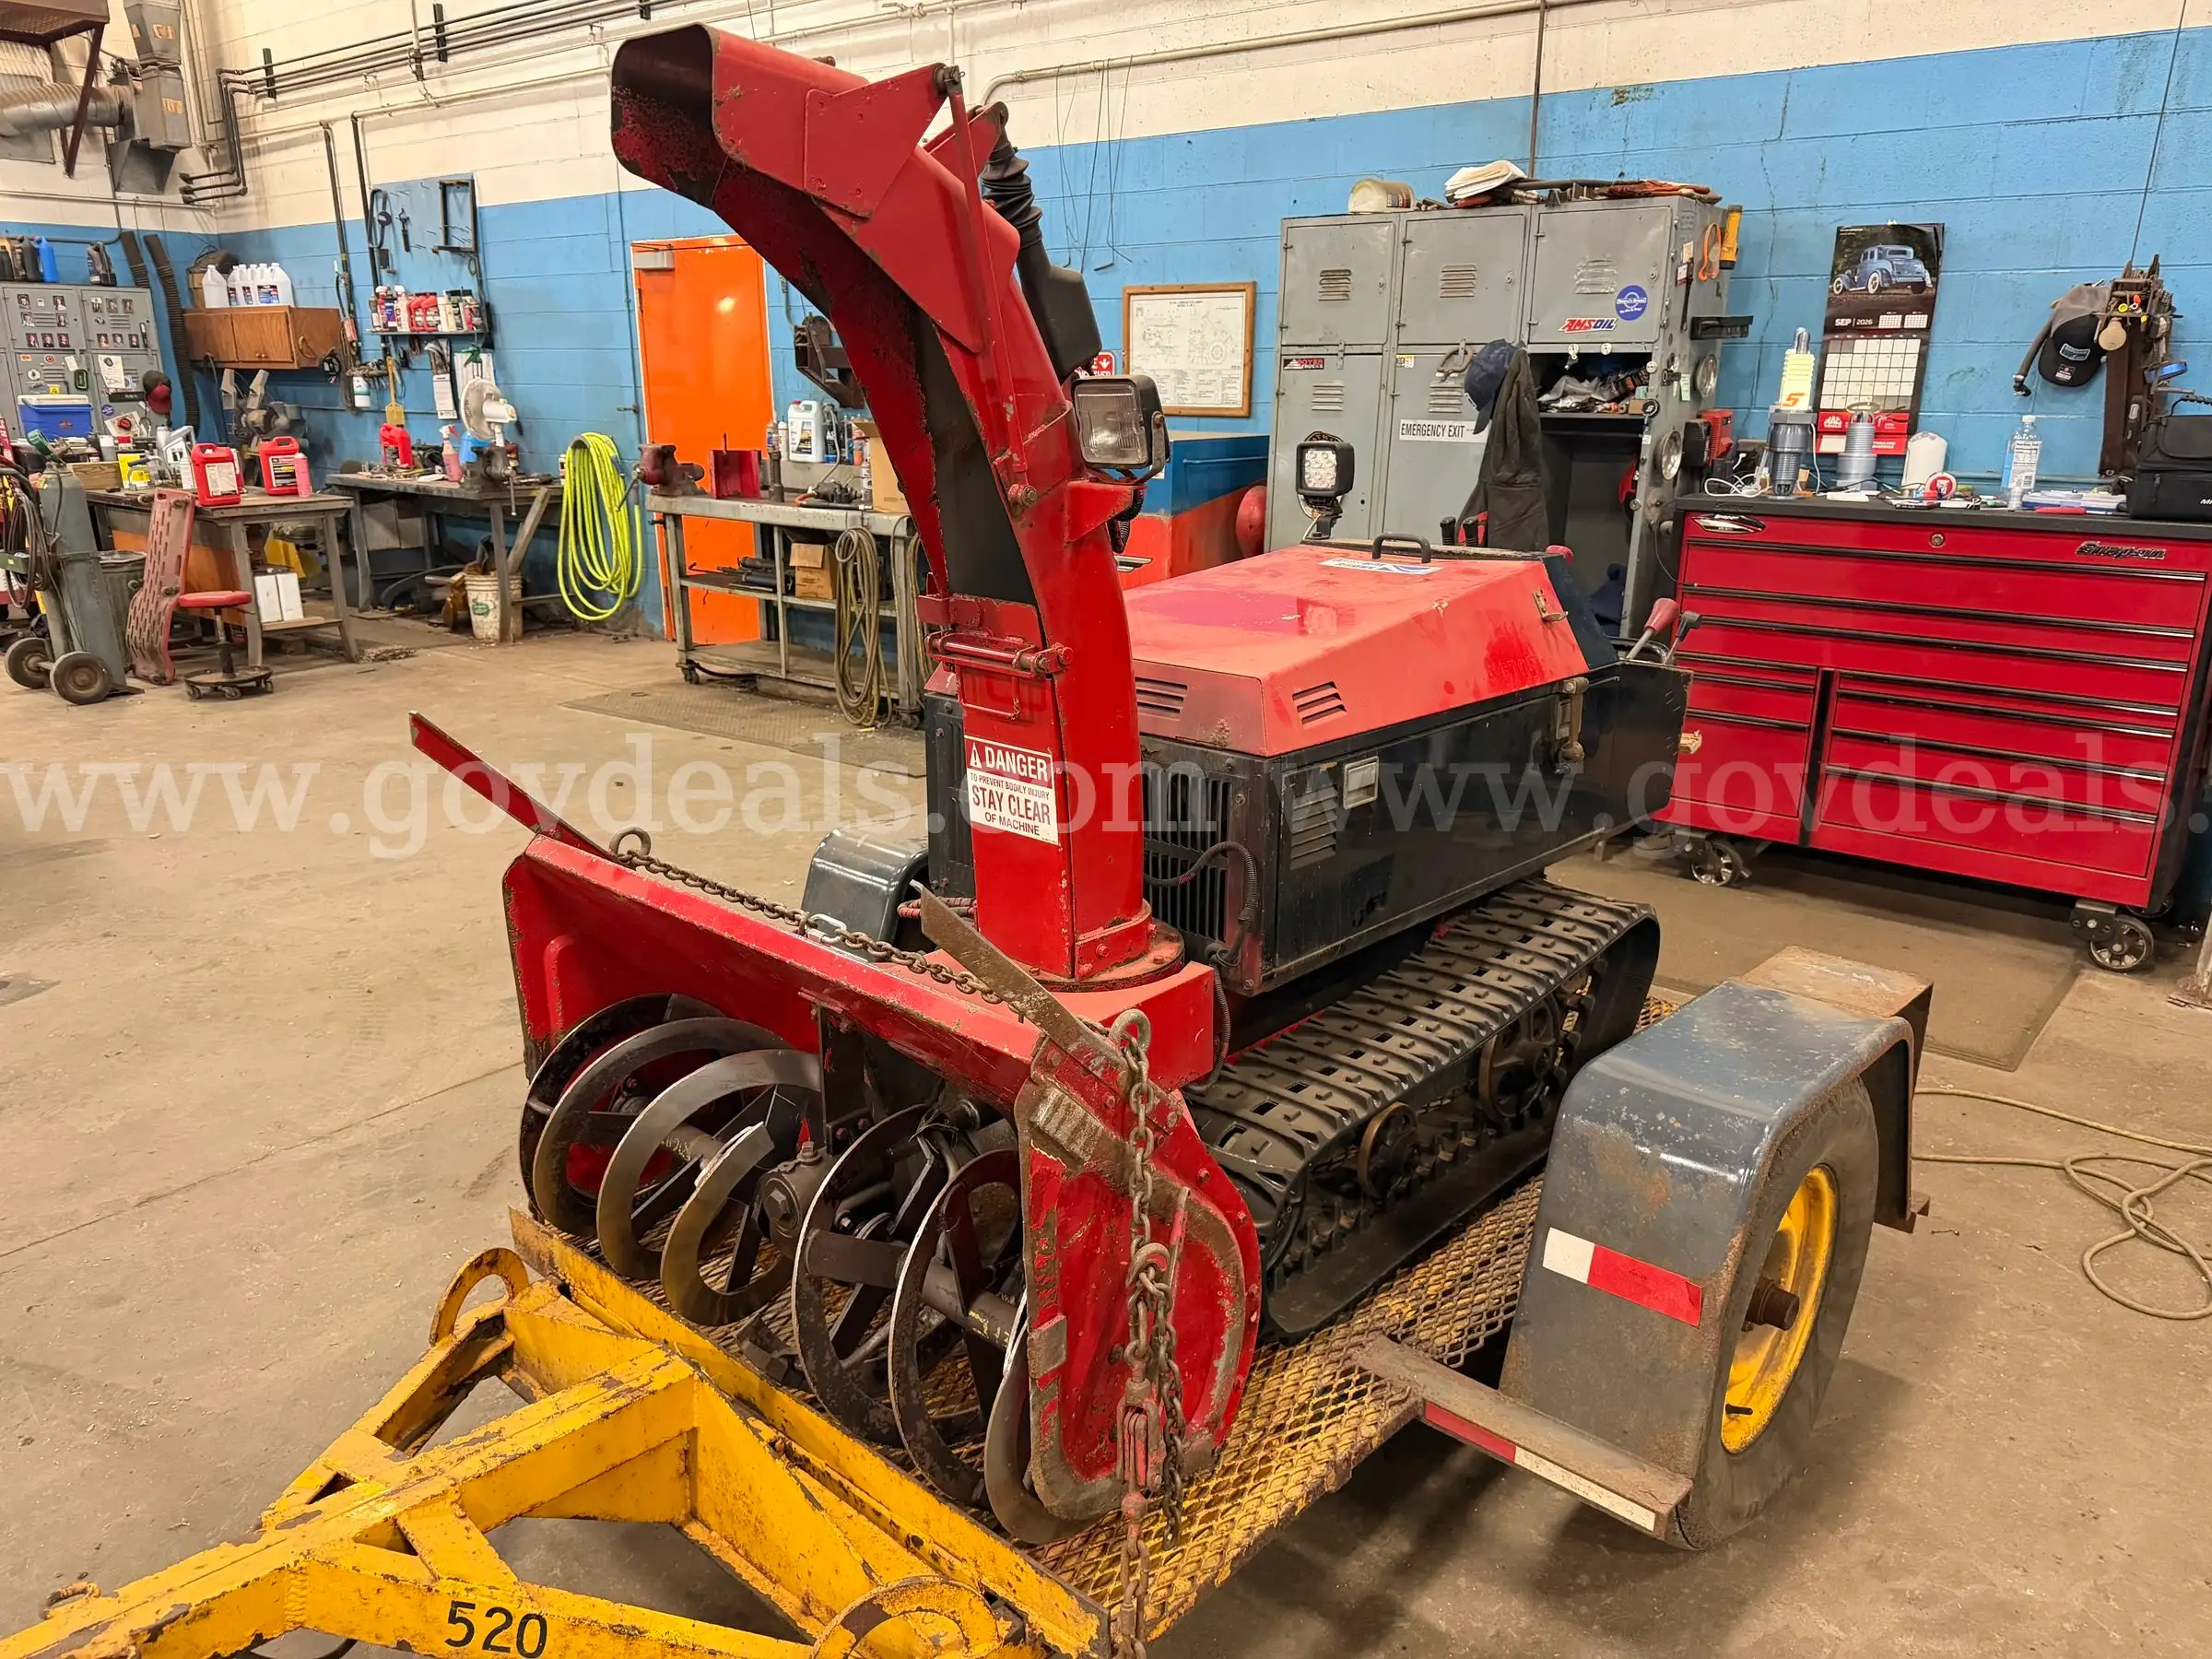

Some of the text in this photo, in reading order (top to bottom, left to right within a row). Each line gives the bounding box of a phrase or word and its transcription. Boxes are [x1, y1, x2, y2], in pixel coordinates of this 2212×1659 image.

[1562, 319, 1615, 332] AMSOIL
[1835, 318, 1852, 326] SEP
[1401, 423, 1465, 438] EMERGENCY EXIT
[984, 746, 1048, 782] DANGER
[970, 772, 1050, 800] TO PREVENT BODILY INJURY
[971, 784, 1051, 825] STAY CLEAR
[984, 812, 1040, 836] OF MACHINE
[444, 1599, 547, 1659] 520
